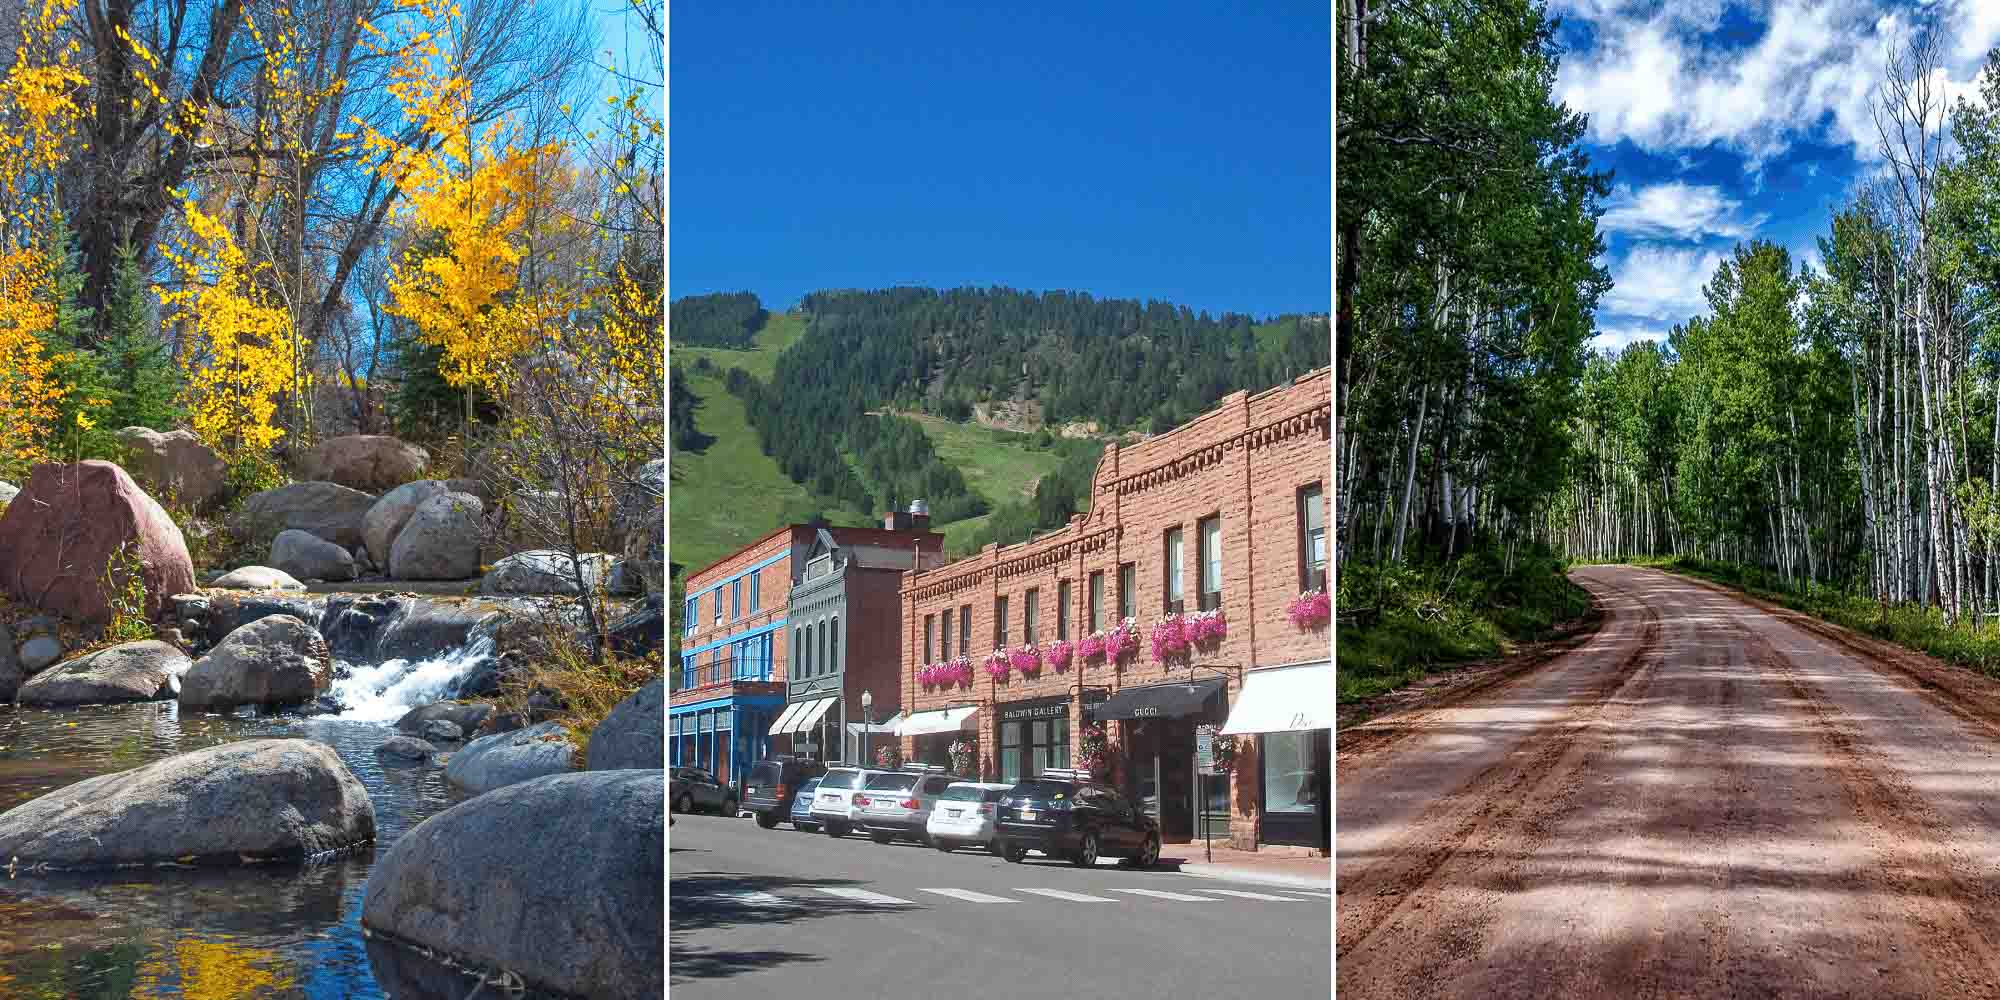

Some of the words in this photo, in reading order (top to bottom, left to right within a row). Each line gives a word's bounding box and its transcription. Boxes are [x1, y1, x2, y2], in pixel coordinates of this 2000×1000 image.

[1004, 709, 1032, 719] BALDWIN
[1034, 705, 1063, 716] GALLERY
[1134, 706, 1157, 717] GUCCI
